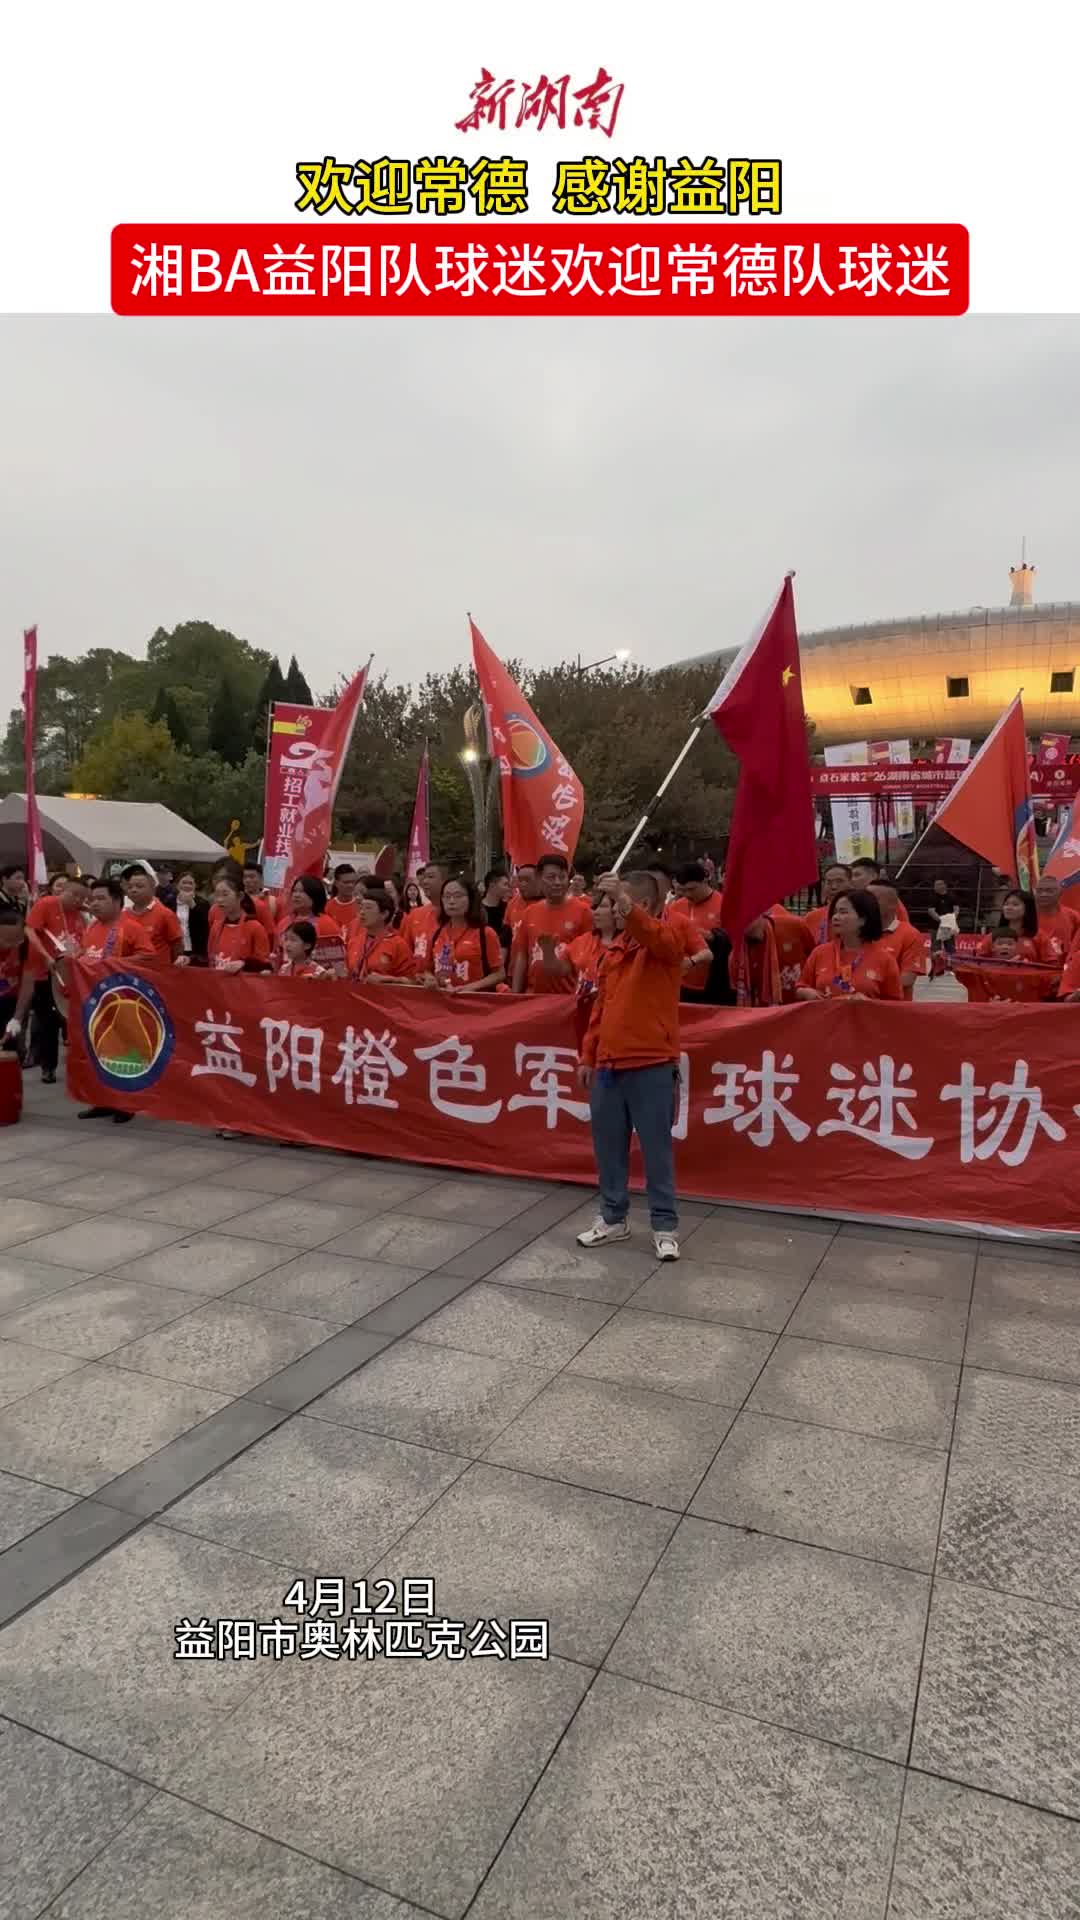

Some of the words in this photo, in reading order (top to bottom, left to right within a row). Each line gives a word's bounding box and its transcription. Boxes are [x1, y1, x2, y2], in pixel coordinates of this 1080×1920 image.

[191, 1008, 1080, 1167] 益阳橙色军球迷协
